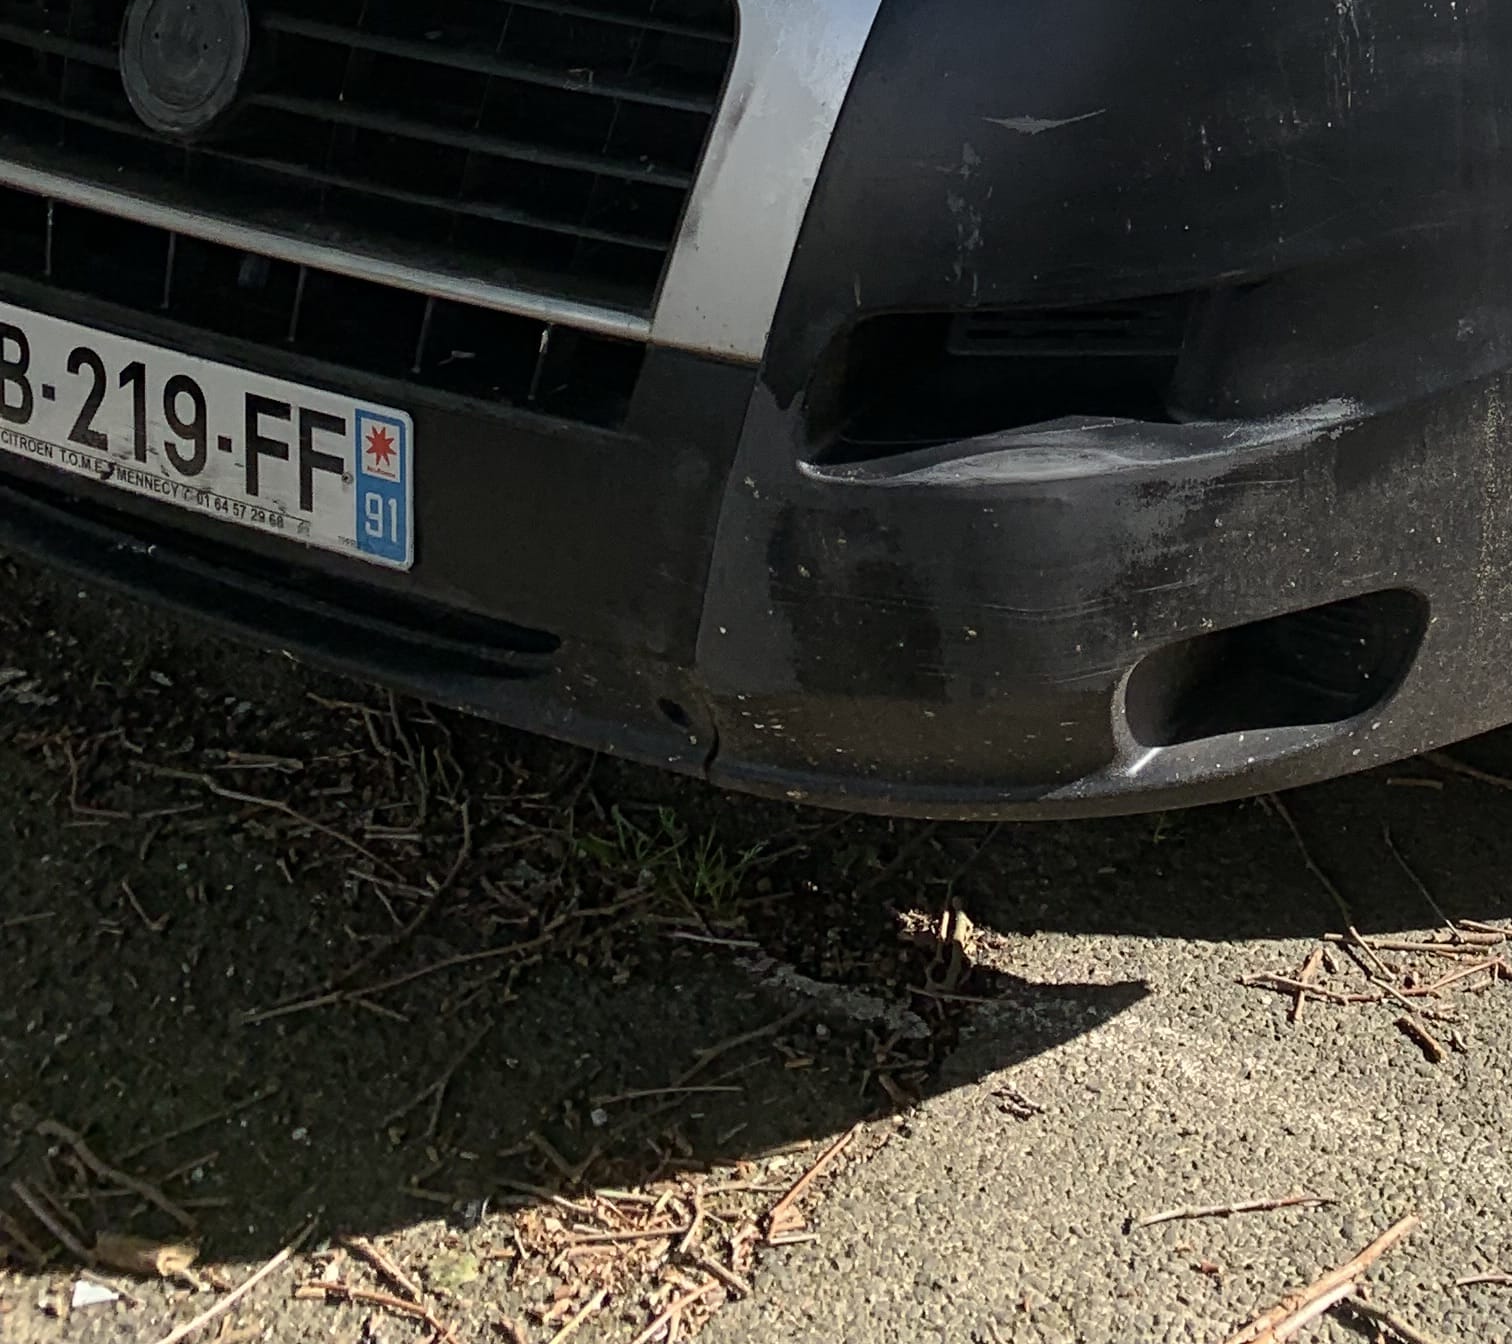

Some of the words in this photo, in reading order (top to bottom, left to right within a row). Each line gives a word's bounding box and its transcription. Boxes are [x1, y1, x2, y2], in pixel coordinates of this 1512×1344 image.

[0, 321, 347, 513] B-219-FF
[0, 429, 53, 459] CITROEN
[117, 467, 178, 498] MENNECY
[215, 497, 229, 514] 64
[233, 503, 247, 520] 57
[251, 509, 265, 523] 29
[364, 492, 398, 543] 91
